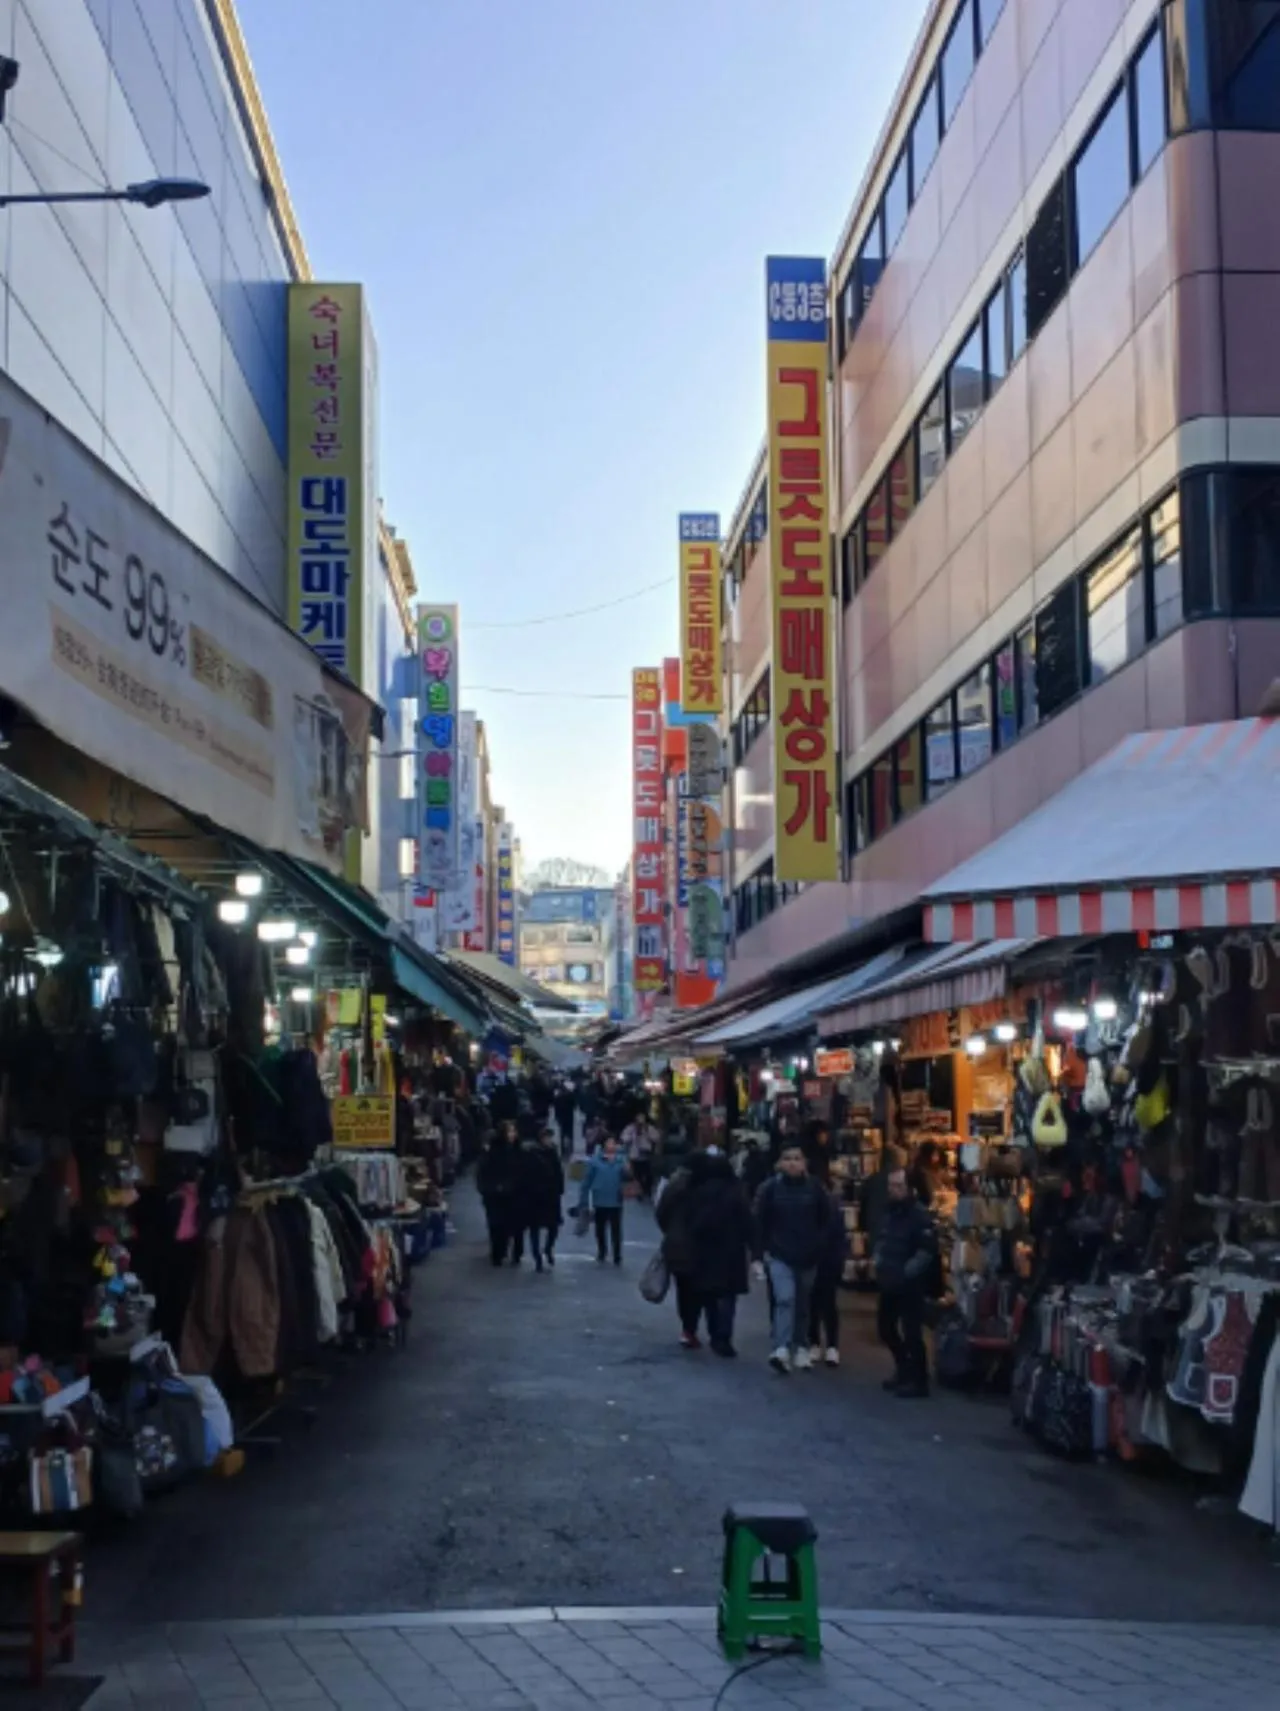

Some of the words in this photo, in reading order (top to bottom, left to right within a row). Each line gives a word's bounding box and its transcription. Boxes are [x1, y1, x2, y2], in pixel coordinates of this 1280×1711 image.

[307, 294, 343, 459] 숙녀복전문
[47, 500, 113, 612] 순도
[122, 552, 187, 668] 99%
[687, 548, 717, 705] 그릇도매상가
[777, 368, 832, 843] 그릇도매상가
